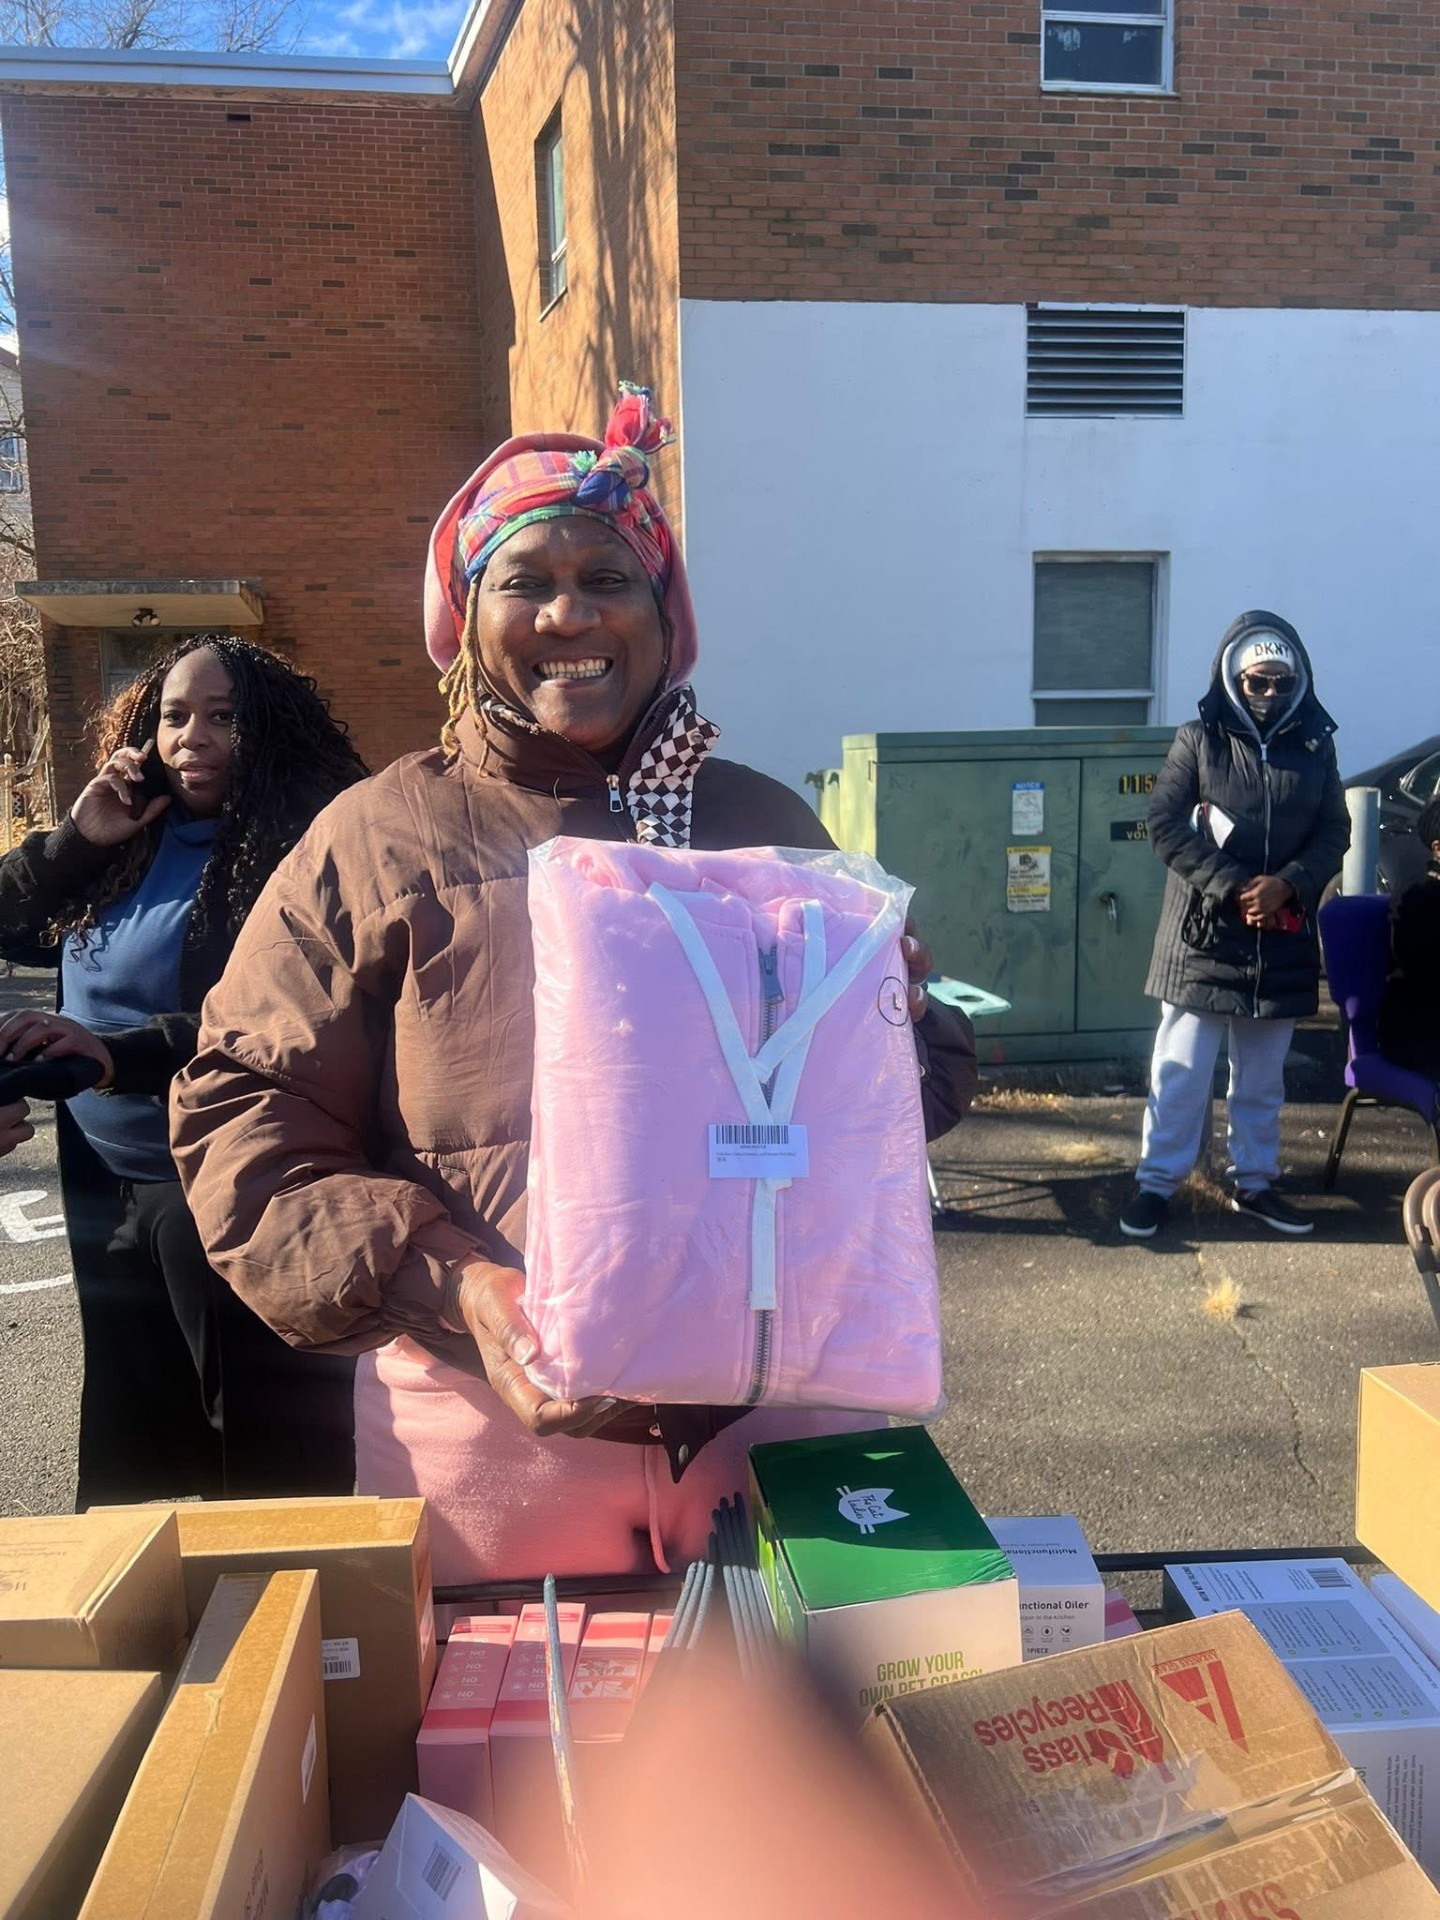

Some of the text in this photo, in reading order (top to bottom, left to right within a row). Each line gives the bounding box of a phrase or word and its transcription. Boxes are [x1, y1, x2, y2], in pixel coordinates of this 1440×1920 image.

[1254, 641, 1289, 659] DKNY
[1126, 831, 1148, 841] VOL
[1065, 1600, 1089, 1610] Oiler
[877, 1651, 964, 1683] GROW YOUR
[973, 1690, 1111, 1746] Recycles
